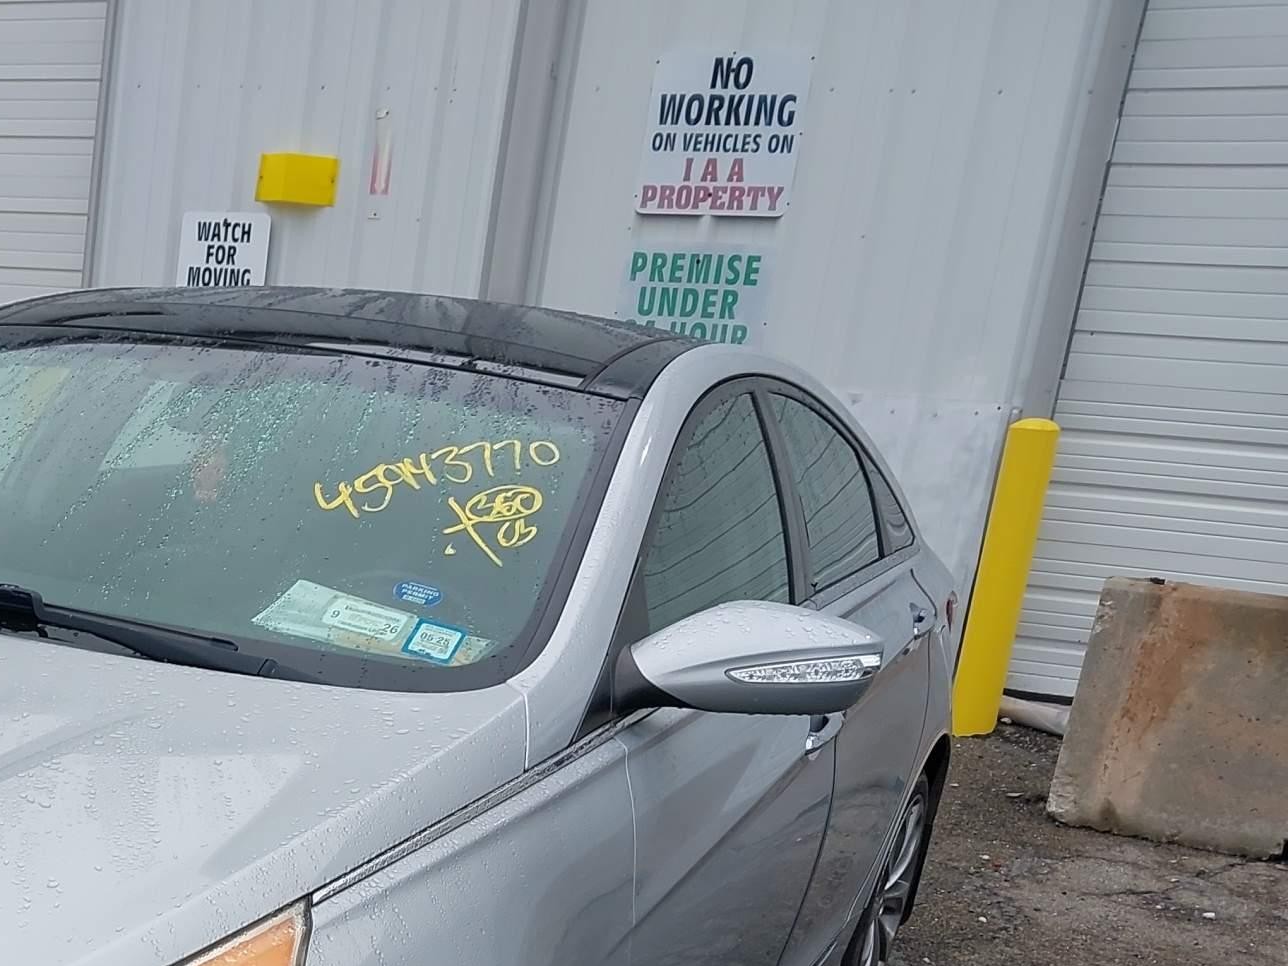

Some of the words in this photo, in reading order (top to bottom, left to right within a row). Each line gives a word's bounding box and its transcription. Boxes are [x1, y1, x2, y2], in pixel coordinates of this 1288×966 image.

[710, 57, 754, 90] NO
[658, 94, 797, 127] WORKING
[651, 132, 677, 152] ON
[683, 133, 762, 153] VEHICLES
[768, 134, 794, 154] ON
[639, 184, 785, 211] PROPERTY
[197, 221, 252, 243] WATCH
[205, 244, 237, 266] FOR
[186, 266, 252, 287] MOVING
[629, 252, 762, 286] PREMISE
[637, 286, 740, 320] UNDER
[330, 610, 340, 619] 9
[383, 623, 400, 634] 26
